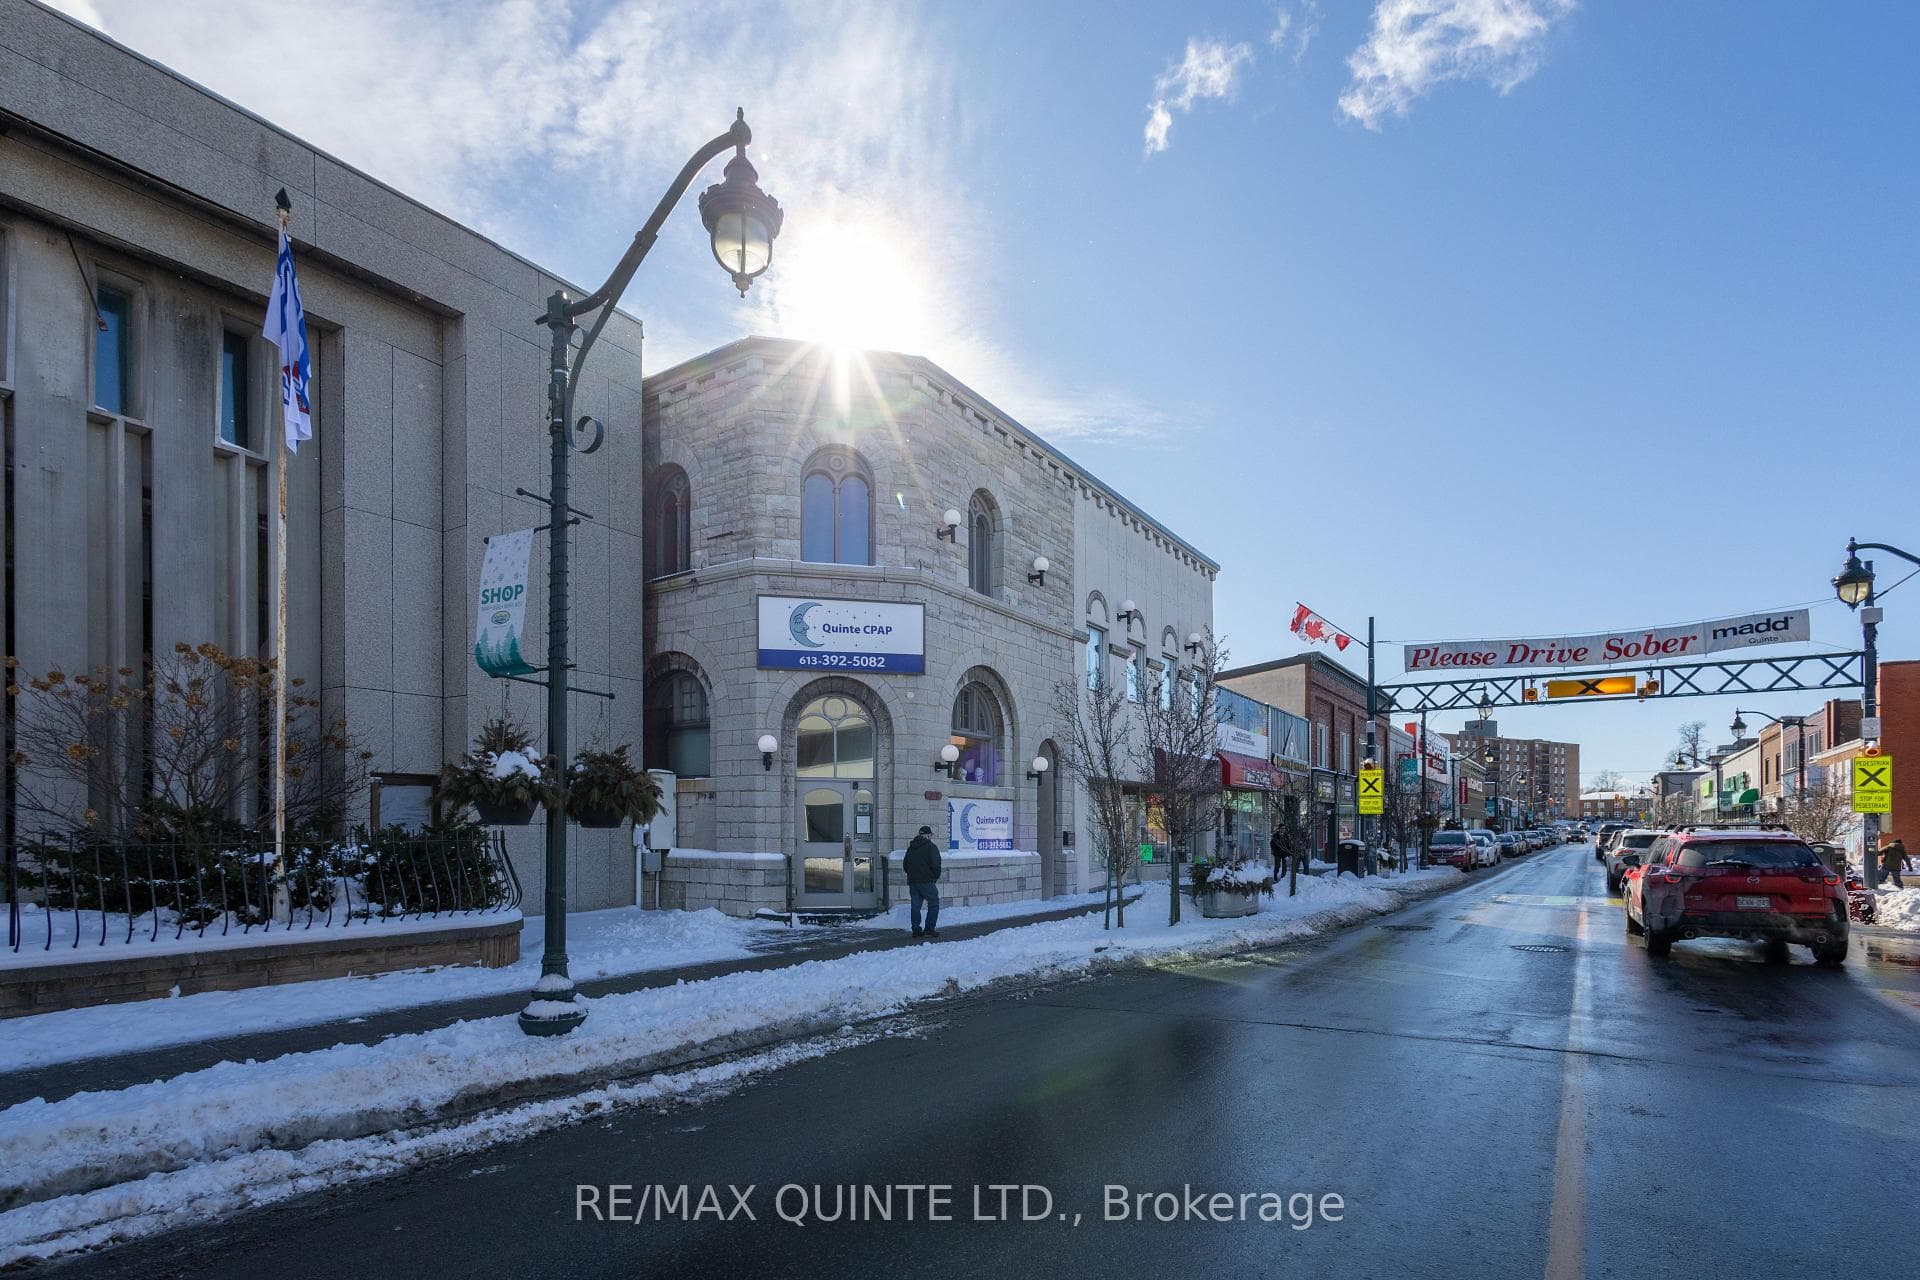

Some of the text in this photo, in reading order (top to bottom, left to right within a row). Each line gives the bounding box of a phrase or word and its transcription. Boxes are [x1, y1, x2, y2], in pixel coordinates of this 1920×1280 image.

[481, 584, 524, 605] SHOP
[822, 623, 893, 635] Quinte CPAP
[1712, 616, 1790, 640] madd
[1748, 636, 1779, 645] Quinte
[1409, 634, 1698, 668] Please Drive Sober
[799, 654, 886, 668] 613-392-5082
[976, 816, 1009, 824] Quinte CPAP
